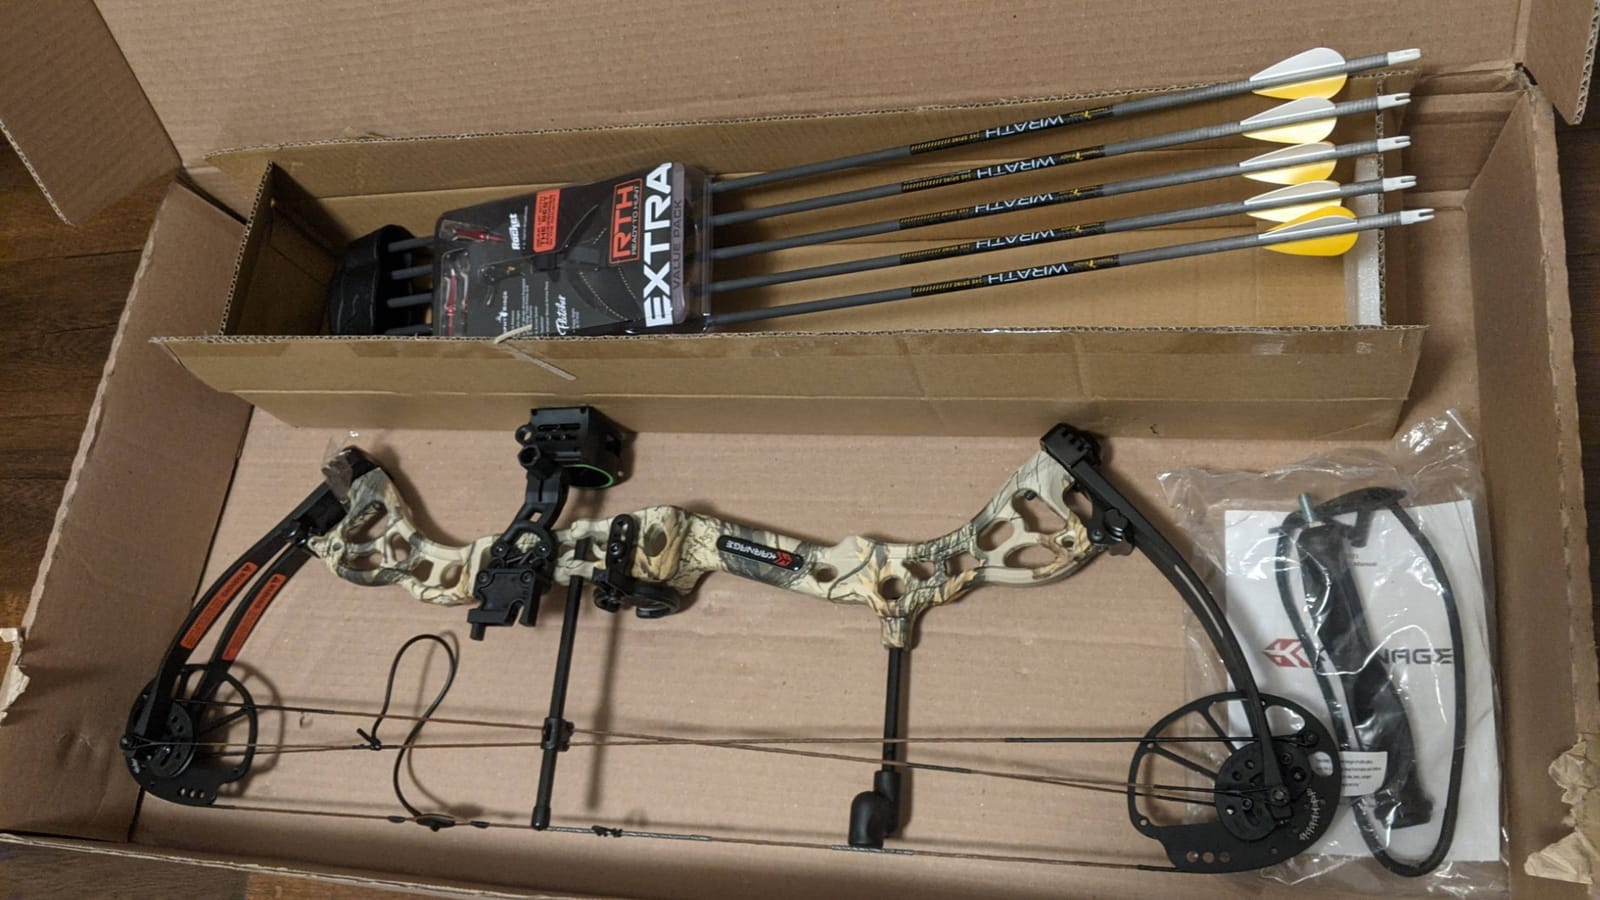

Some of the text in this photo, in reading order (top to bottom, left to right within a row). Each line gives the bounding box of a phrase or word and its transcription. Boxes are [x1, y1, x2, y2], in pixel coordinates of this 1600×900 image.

[986, 115, 1064, 138] WRATH
[976, 156, 1056, 178] WRATH
[975, 194, 1053, 213] WRATH
[613, 185, 634, 259] RTH
[632, 210, 638, 224] TO
[509, 213, 520, 250] Rocket
[976, 230, 1054, 249] WRATH
[643, 162, 673, 327] EXTRA
[673, 200, 683, 290] VALUE PACK
[988, 264, 1068, 284] WRATH
[555, 294, 570, 336] Fletcher
[726, 540, 777, 560] KARNAGE
